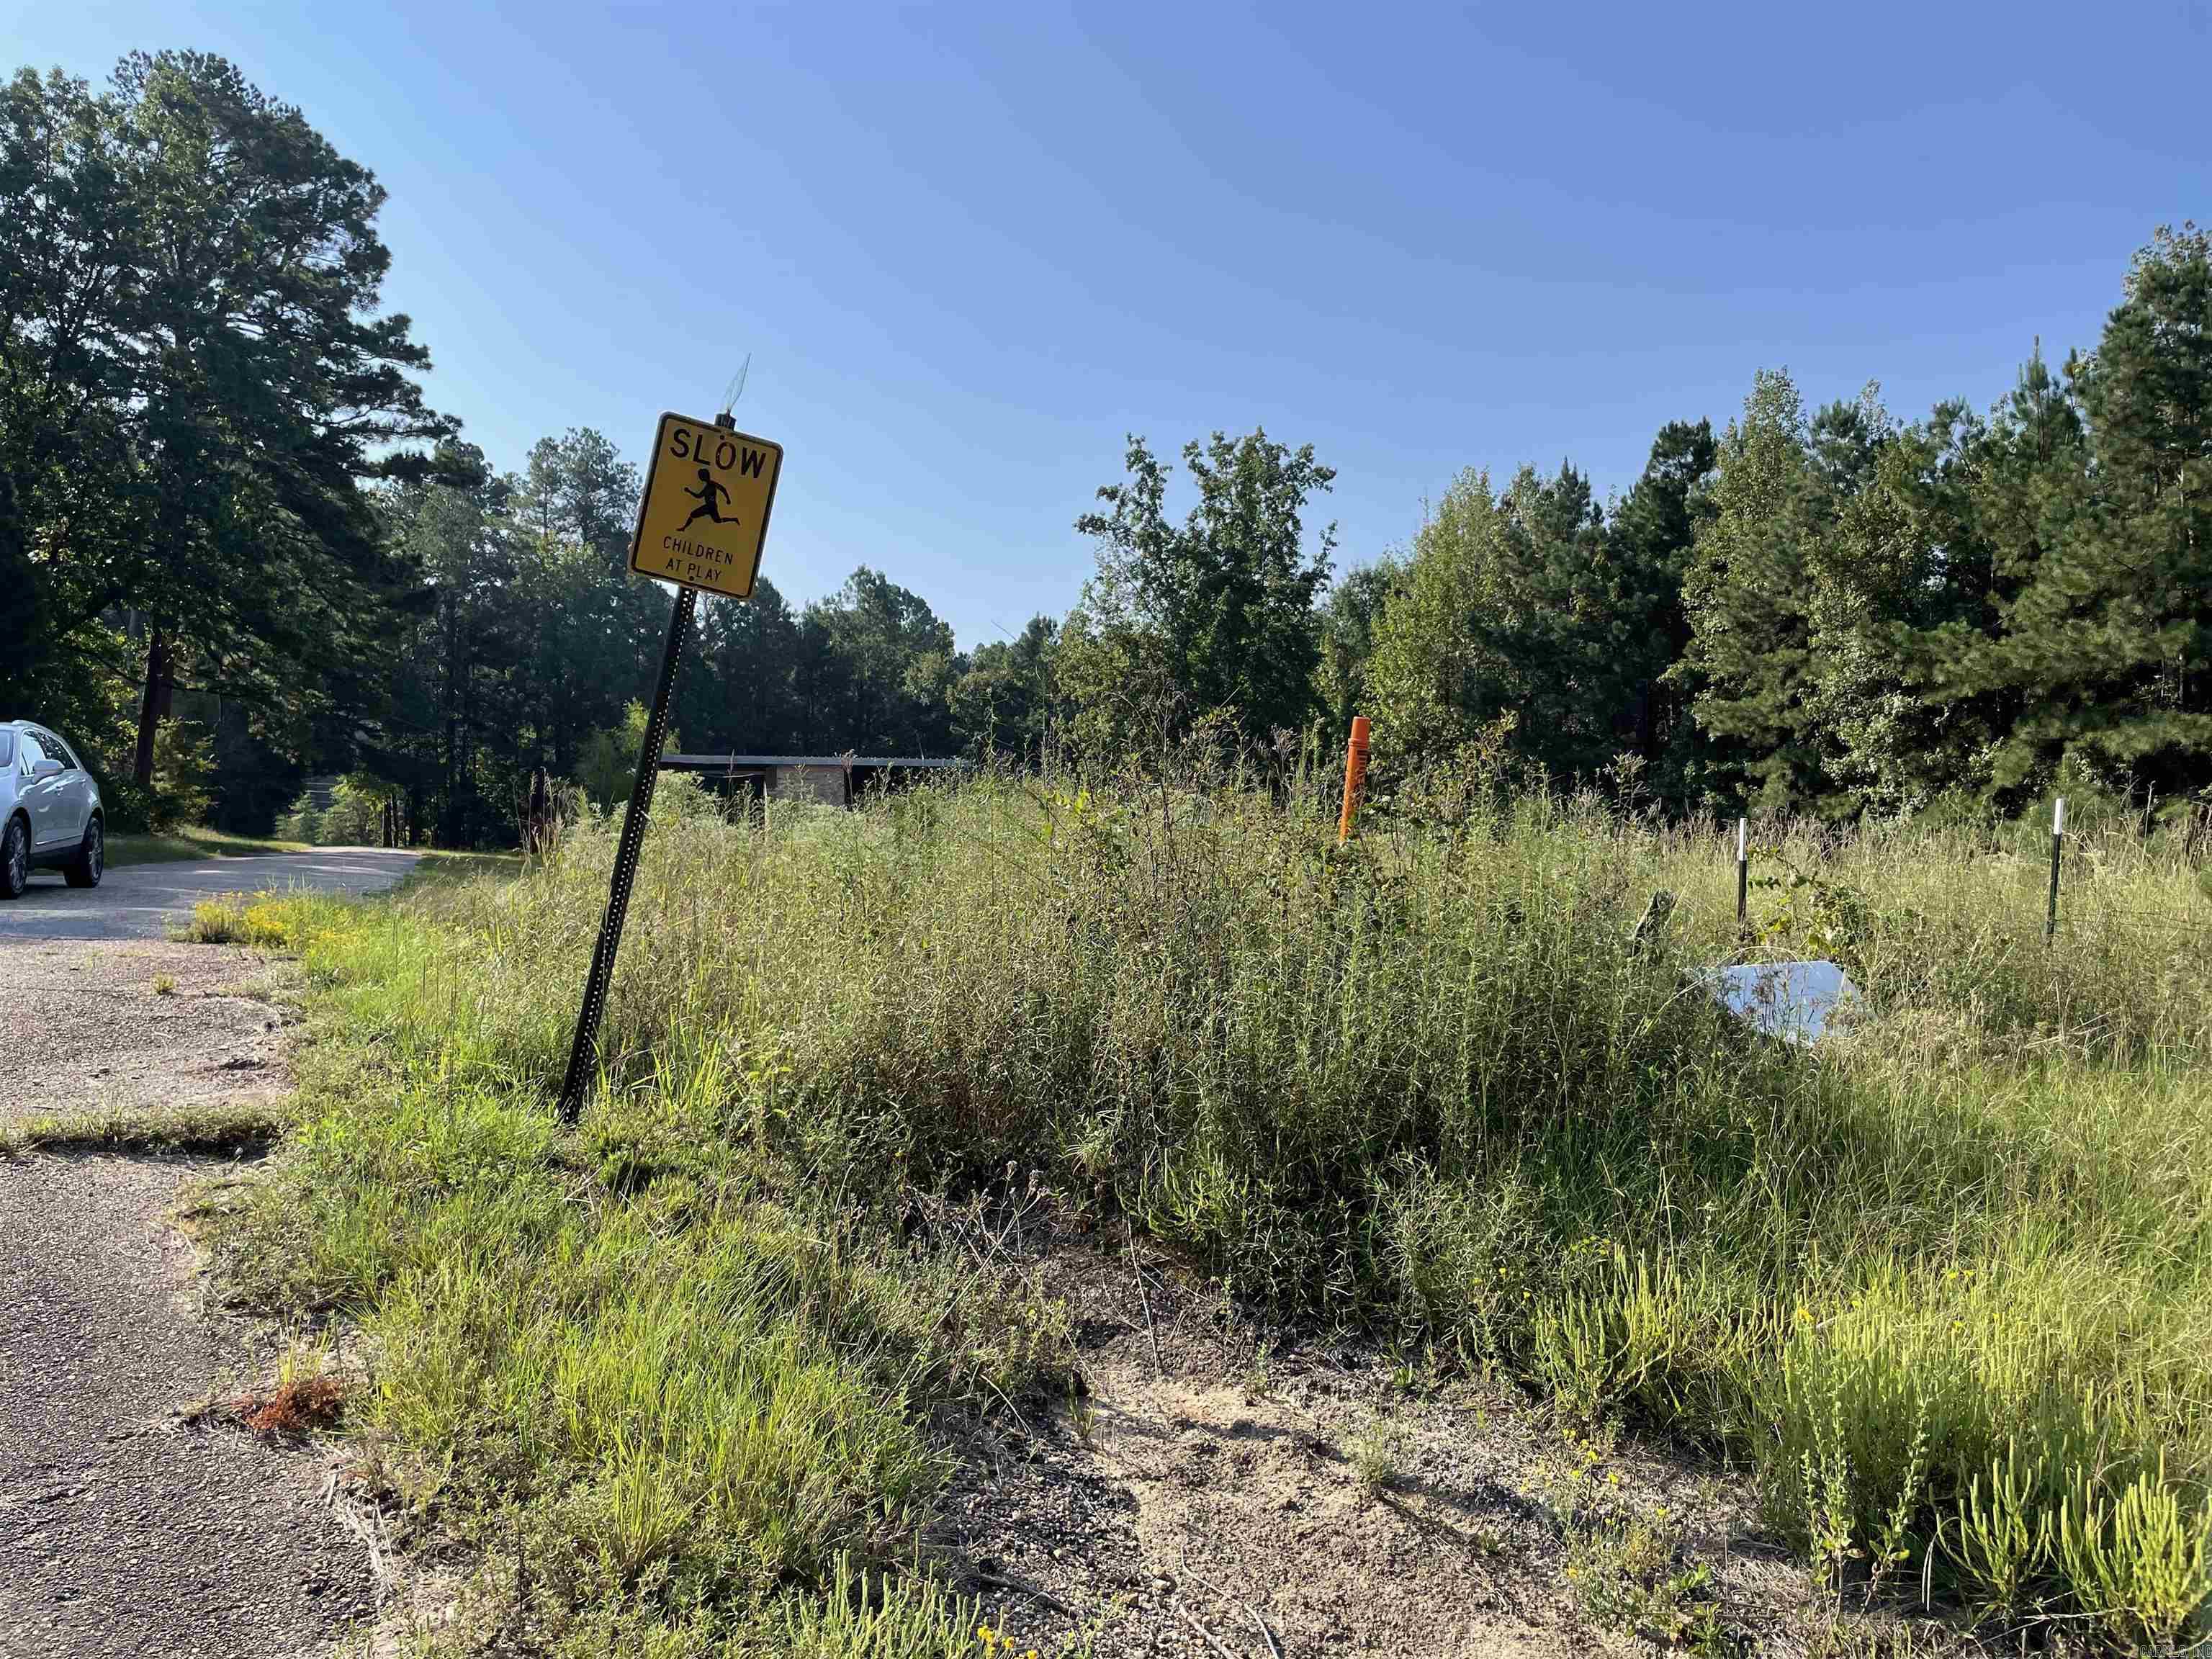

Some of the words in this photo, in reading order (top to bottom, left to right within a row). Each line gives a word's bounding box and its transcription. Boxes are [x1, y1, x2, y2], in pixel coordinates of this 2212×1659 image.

[670, 428, 766, 478] SLOW
[663, 536, 733, 565] CHILDREN
[666, 558, 682, 571] AT
[687, 563, 721, 581] PLAY
